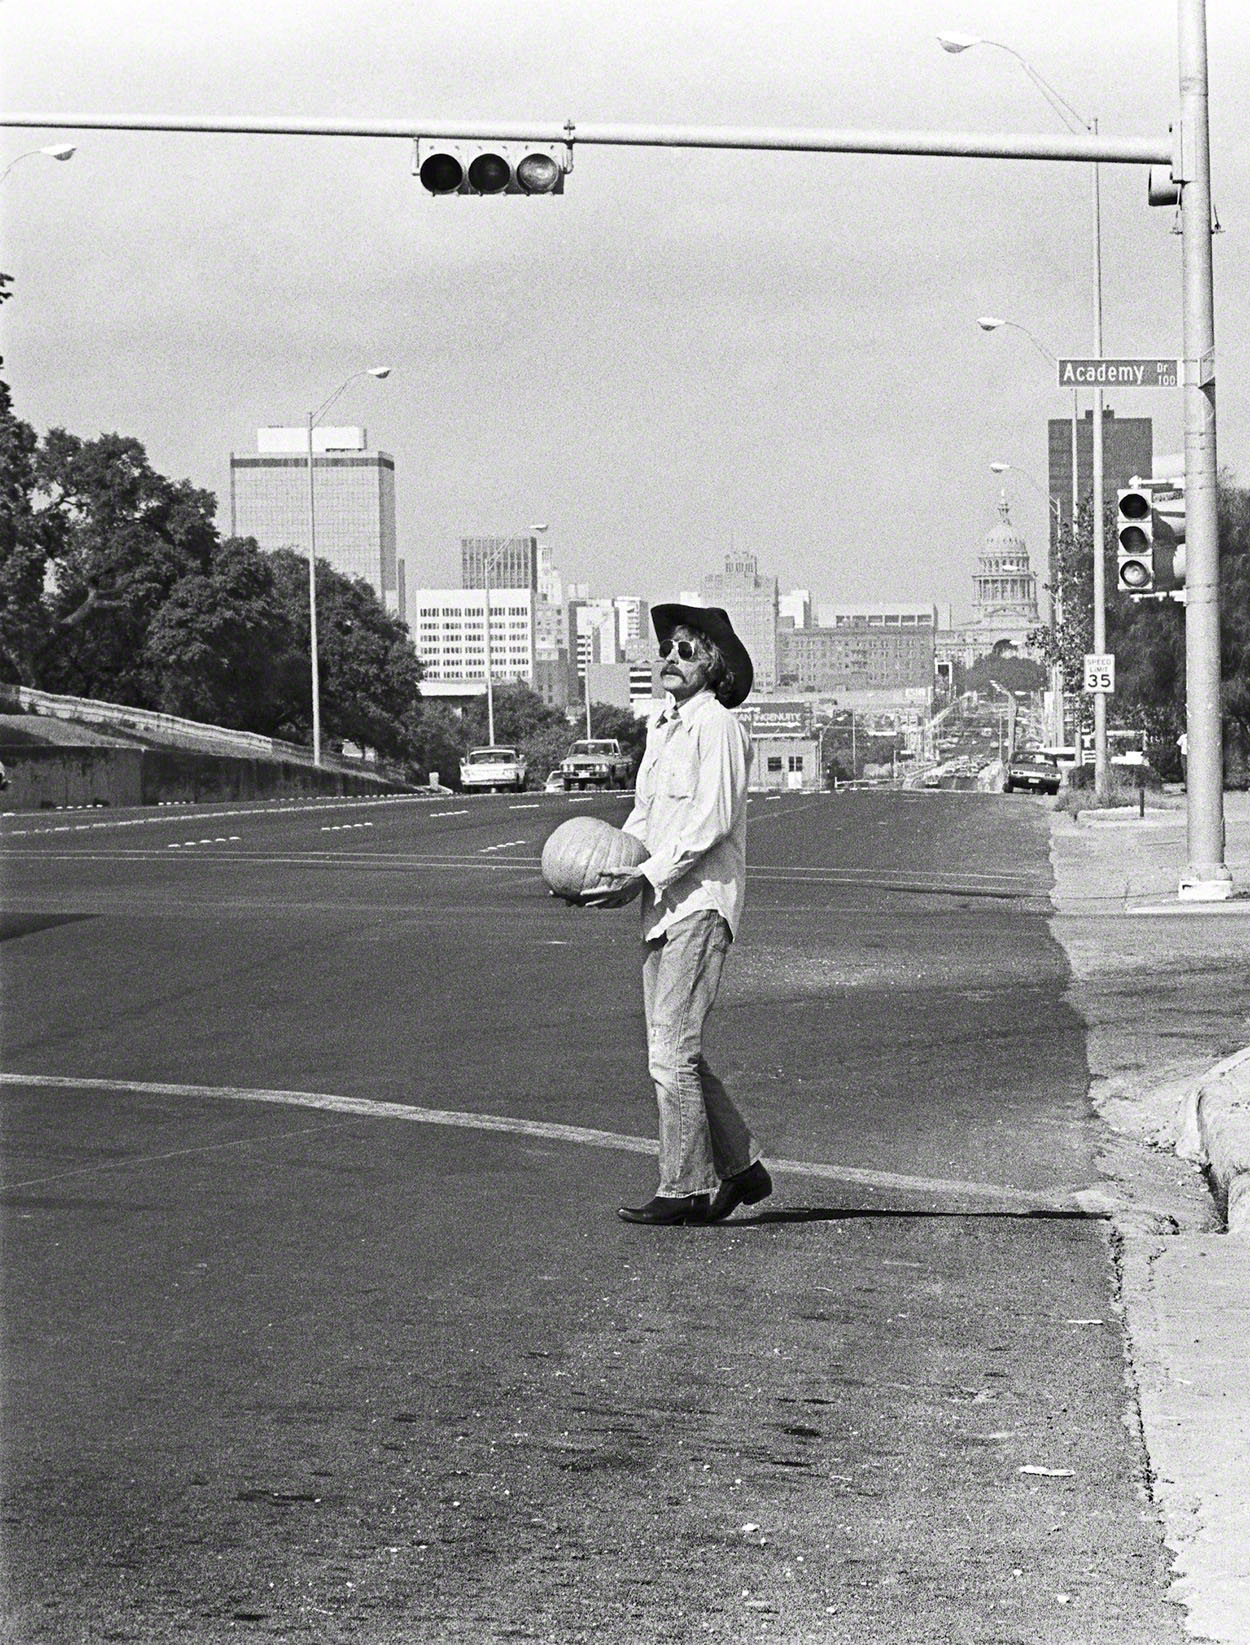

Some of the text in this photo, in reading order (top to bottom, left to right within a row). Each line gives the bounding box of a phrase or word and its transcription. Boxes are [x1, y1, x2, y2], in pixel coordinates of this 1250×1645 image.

[1063, 362, 1168, 385] Academy Dr
[1158, 375, 1176, 386] 100
[1088, 674, 1111, 688] 35
